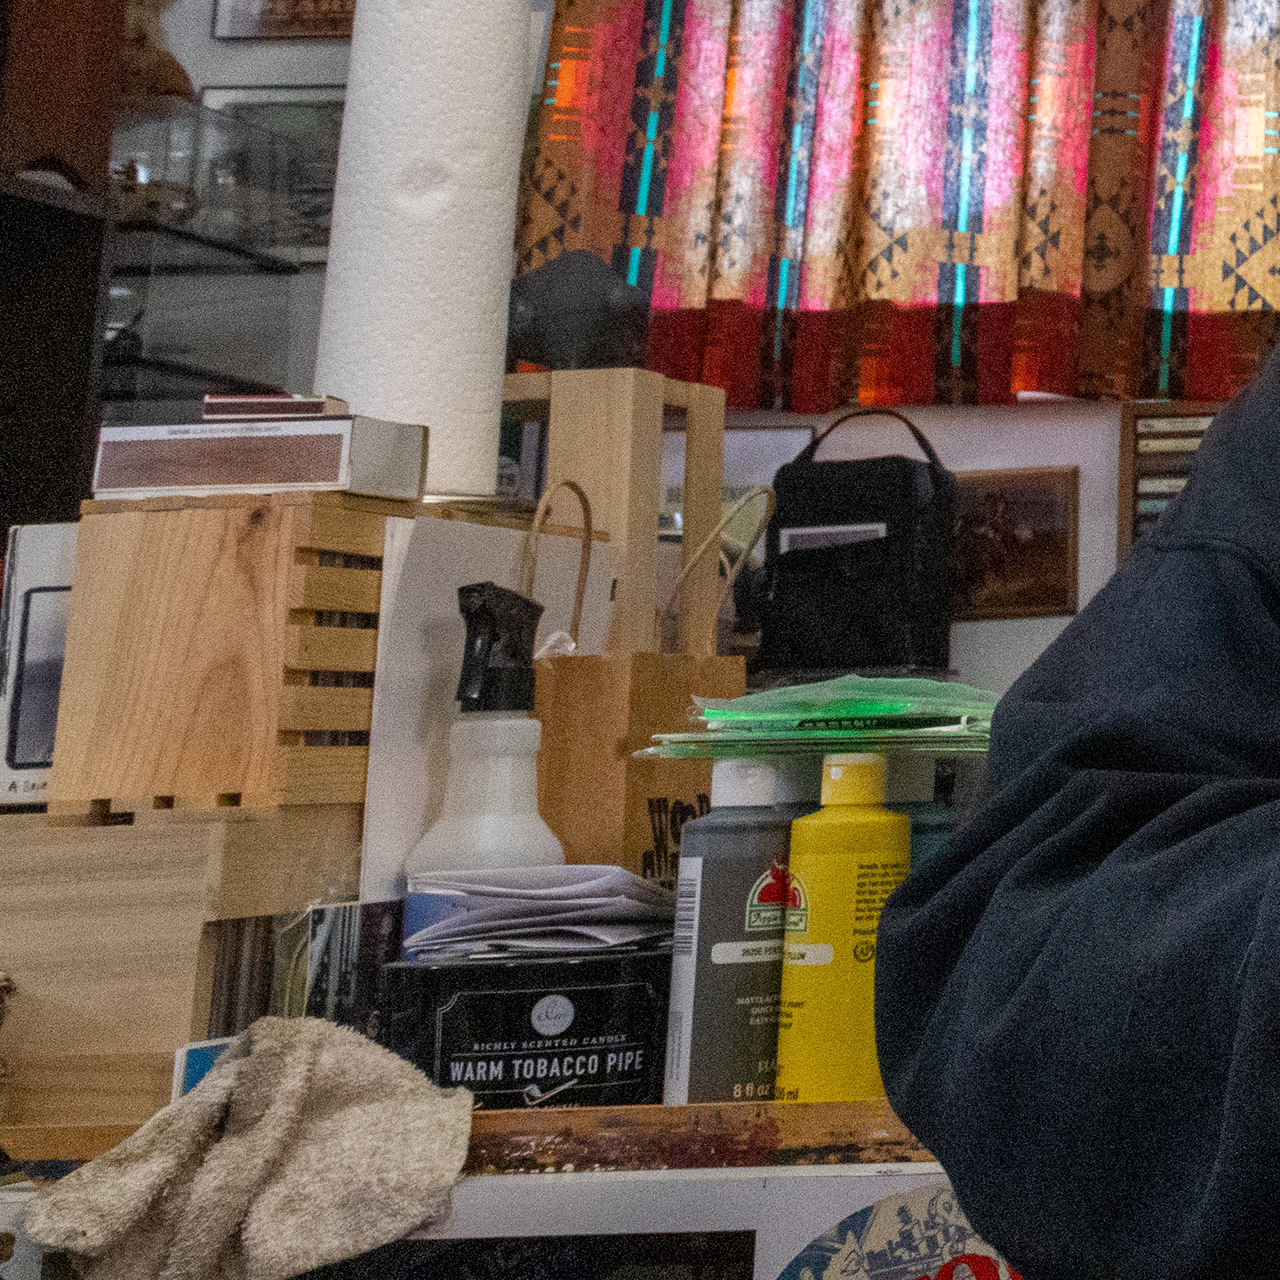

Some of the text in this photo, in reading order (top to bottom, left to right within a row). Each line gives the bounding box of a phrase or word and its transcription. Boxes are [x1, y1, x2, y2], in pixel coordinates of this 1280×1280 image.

[472, 1041, 517, 1052] RICHLY
[521, 1037, 578, 1050] SCENTED
[449, 1049, 645, 1082] WARM TOBACCO PIPE
[732, 1082, 743, 1099] 8
